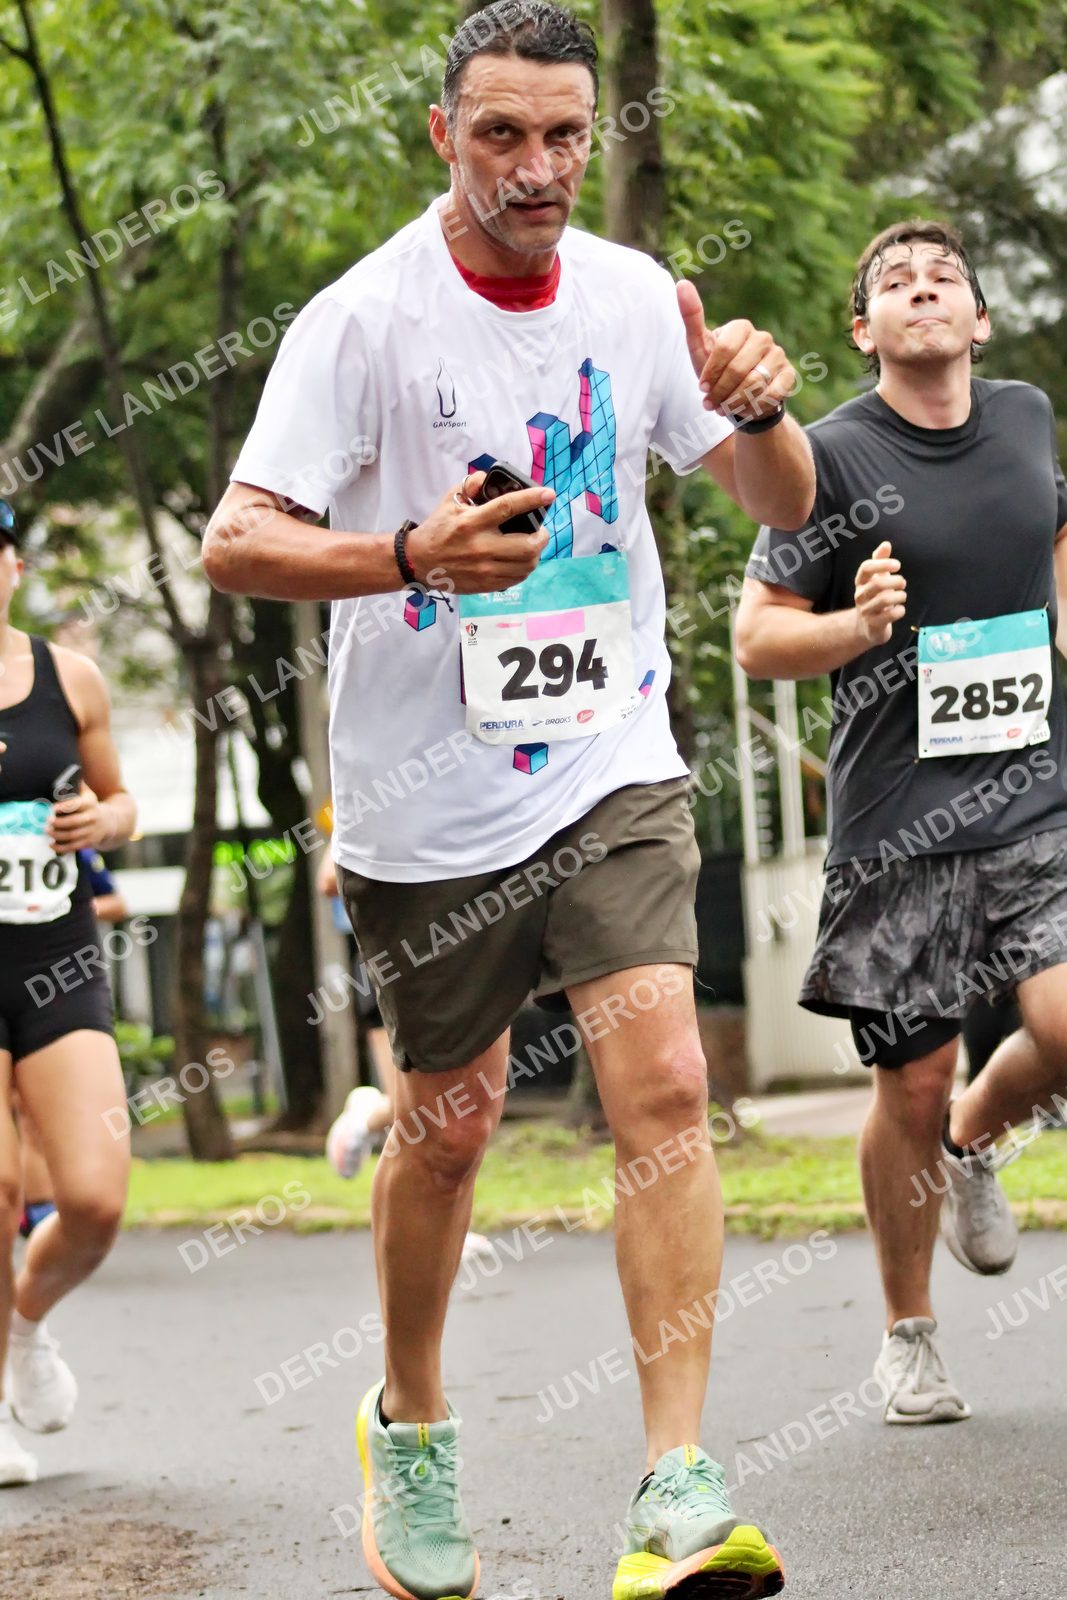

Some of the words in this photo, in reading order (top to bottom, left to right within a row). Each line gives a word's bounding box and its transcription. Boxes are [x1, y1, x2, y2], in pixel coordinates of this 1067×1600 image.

[432, 420, 467, 429] GAVSport
[497, 638, 609, 701] 294
[930, 672, 1045, 724] 2852
[479, 719, 524, 731] PERDURA
[544, 716, 572, 726] BROOKS
